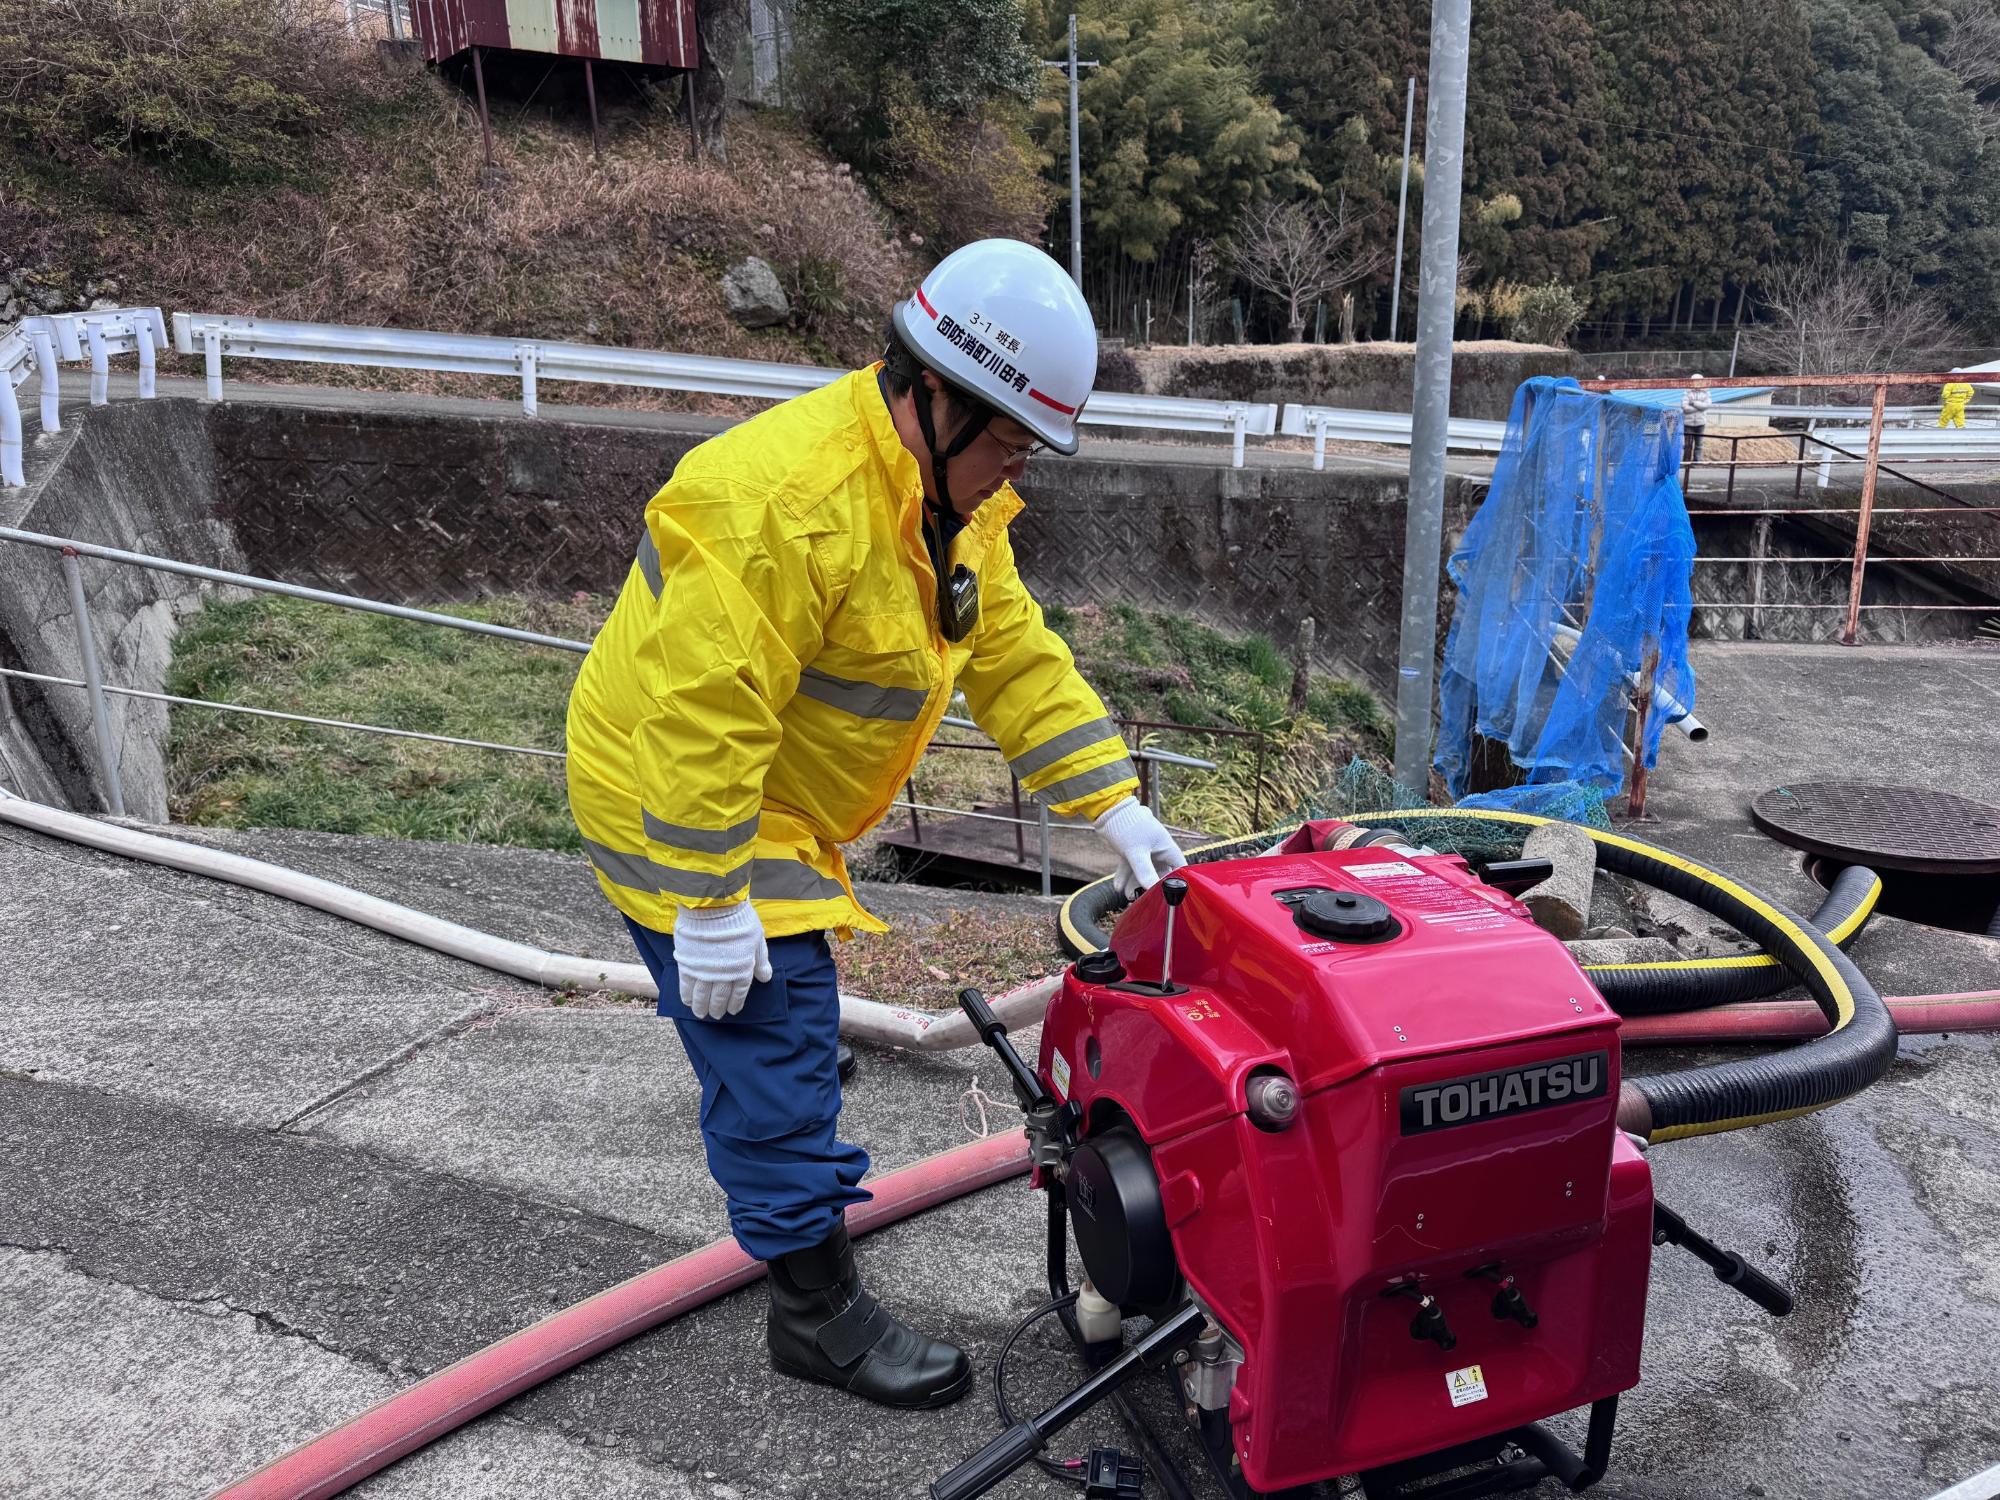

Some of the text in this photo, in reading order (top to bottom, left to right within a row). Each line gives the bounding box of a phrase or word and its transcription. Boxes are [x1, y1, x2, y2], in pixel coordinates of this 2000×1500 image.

[969, 313, 1020, 353] 3-1 班長
[1415, 1057, 1598, 1126] TOHATSU
